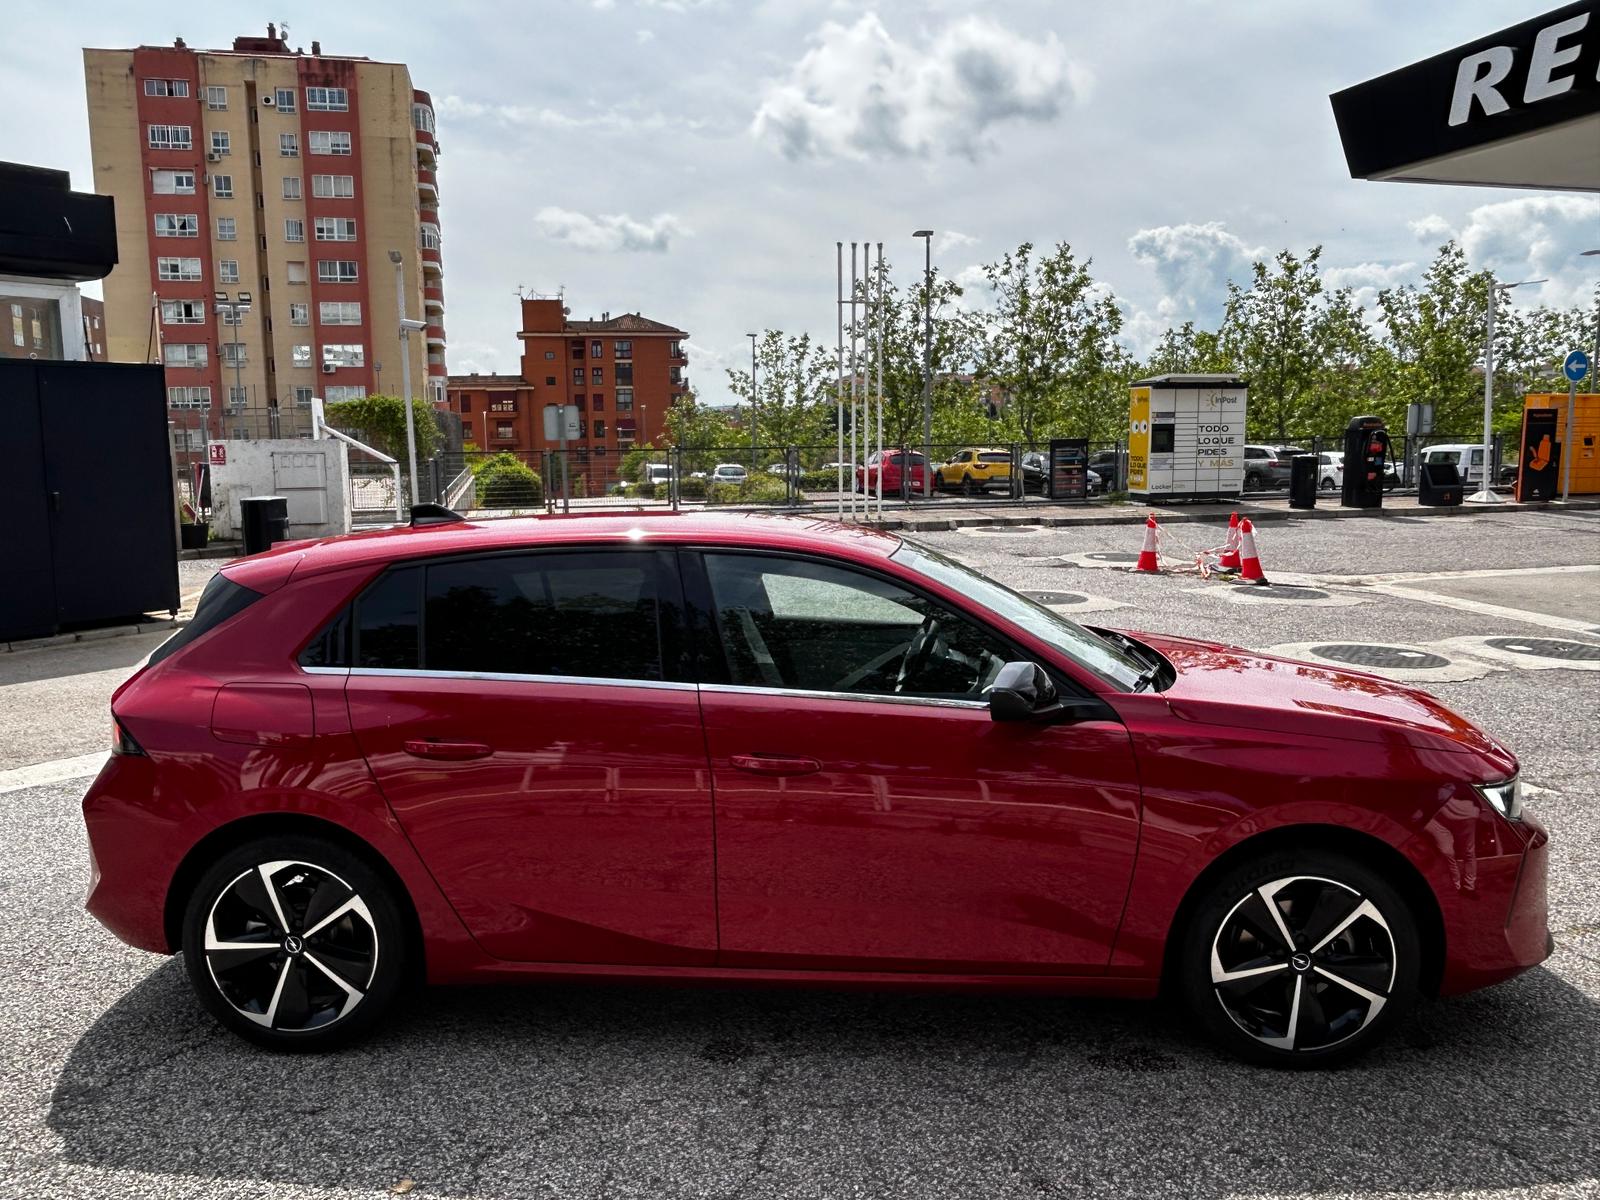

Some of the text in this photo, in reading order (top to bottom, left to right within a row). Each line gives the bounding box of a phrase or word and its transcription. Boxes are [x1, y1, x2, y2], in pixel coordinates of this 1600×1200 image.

[1448, 11, 1600, 127] RE
[1215, 396, 1237, 404] InPost
[1199, 425, 1229, 433] TODO
[1198, 437, 1235, 445] LO QUE
[1197, 448, 1227, 456] PIDES
[1198, 460, 1204, 468] Y
